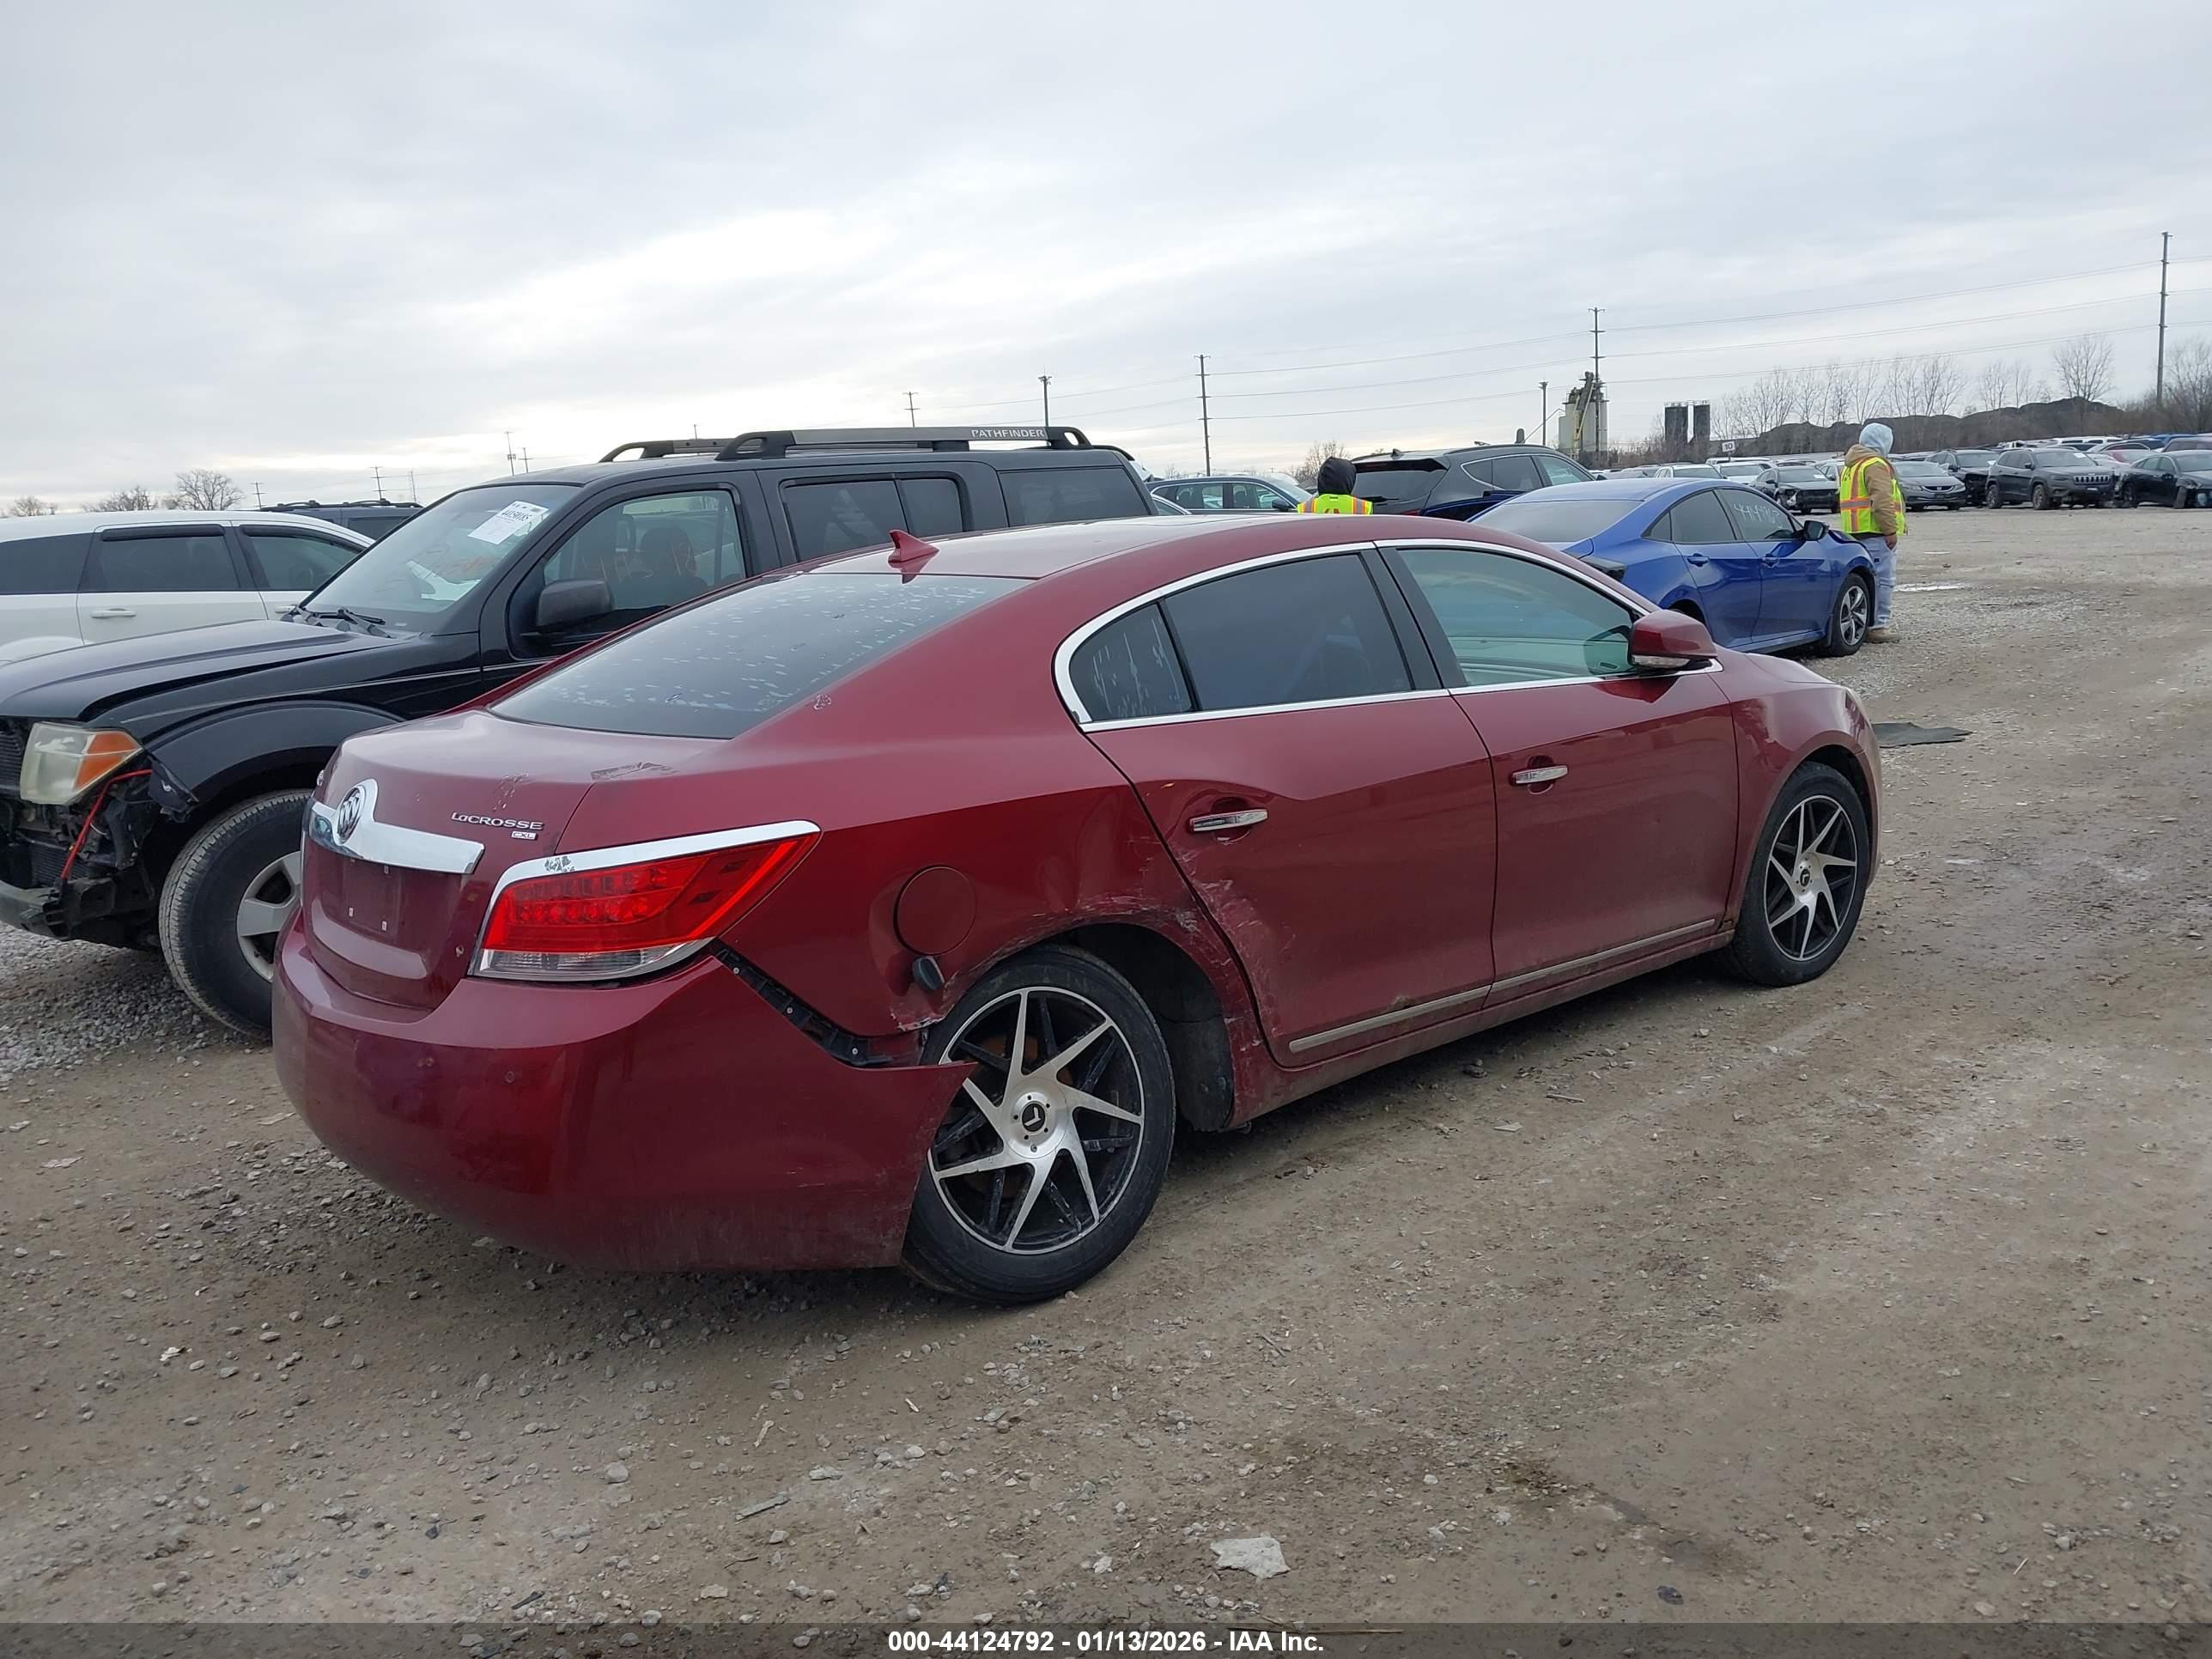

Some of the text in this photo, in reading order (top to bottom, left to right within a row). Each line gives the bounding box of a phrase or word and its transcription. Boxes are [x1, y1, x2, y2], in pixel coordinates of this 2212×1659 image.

[971, 429, 1045, 438] PATHFINDER
[451, 811, 544, 830] LaCROSSE
[511, 831, 537, 840] CXL
